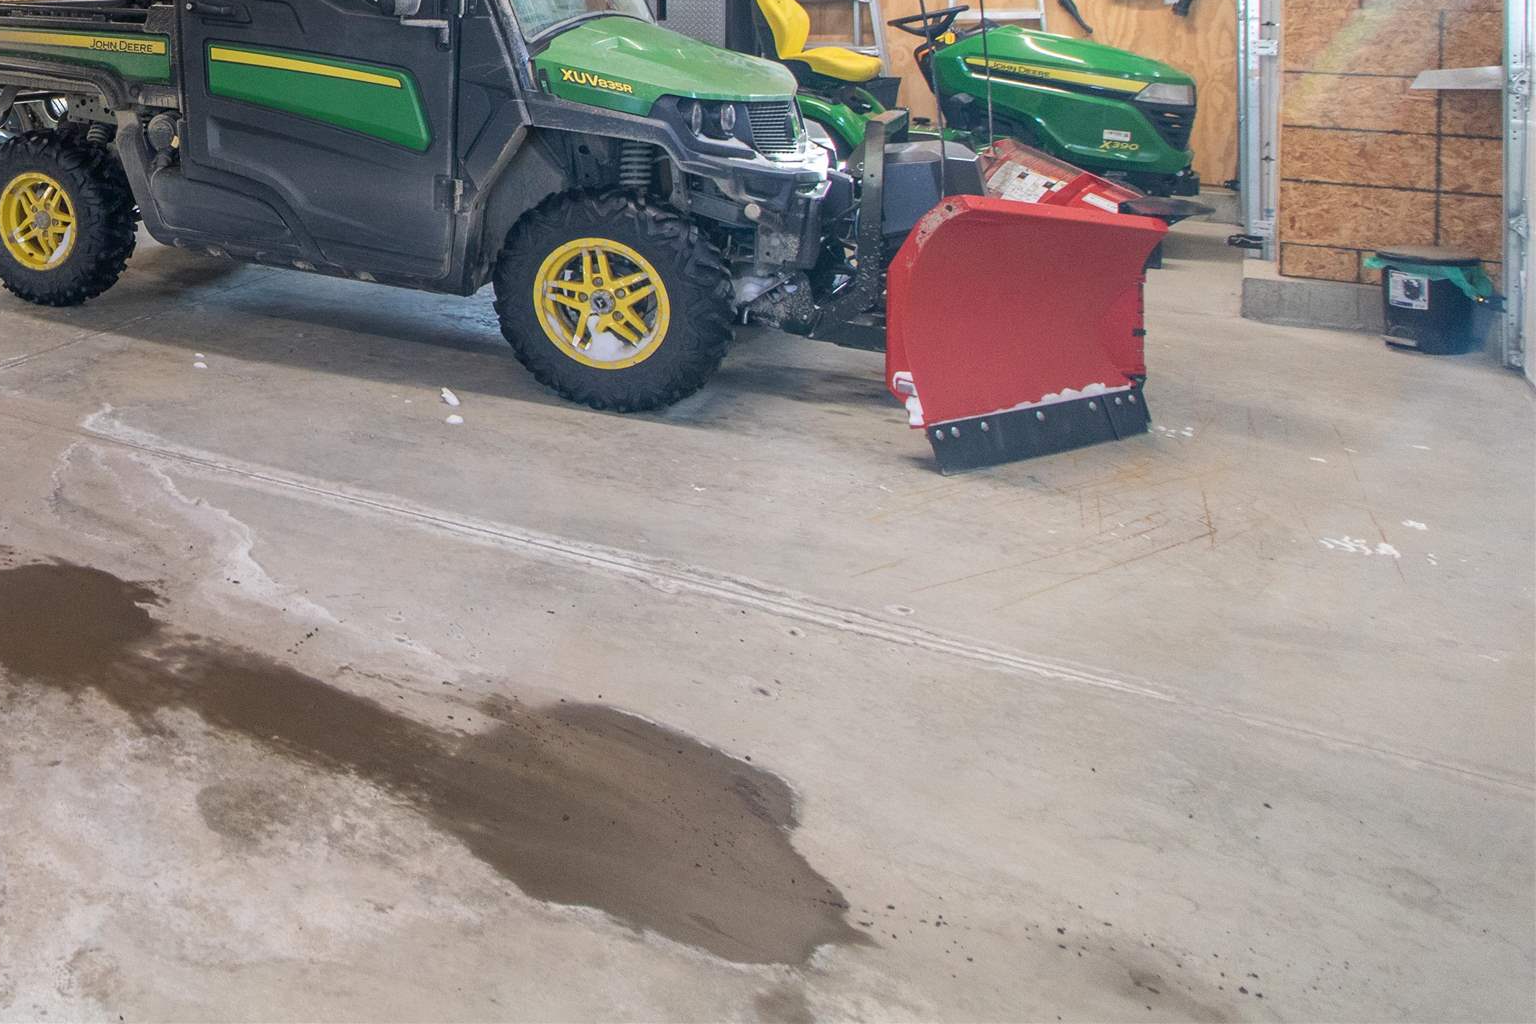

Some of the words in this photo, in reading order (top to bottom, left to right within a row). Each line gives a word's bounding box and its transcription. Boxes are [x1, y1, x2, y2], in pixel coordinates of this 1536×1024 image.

[90, 38, 117, 49] JOHN
[119, 40, 153, 53] DEERE
[992, 61, 1017, 72] JOHN
[1018, 66, 1051, 79] DEERE
[560, 68, 633, 93] XUV835R
[1099, 140, 1140, 151] X390
